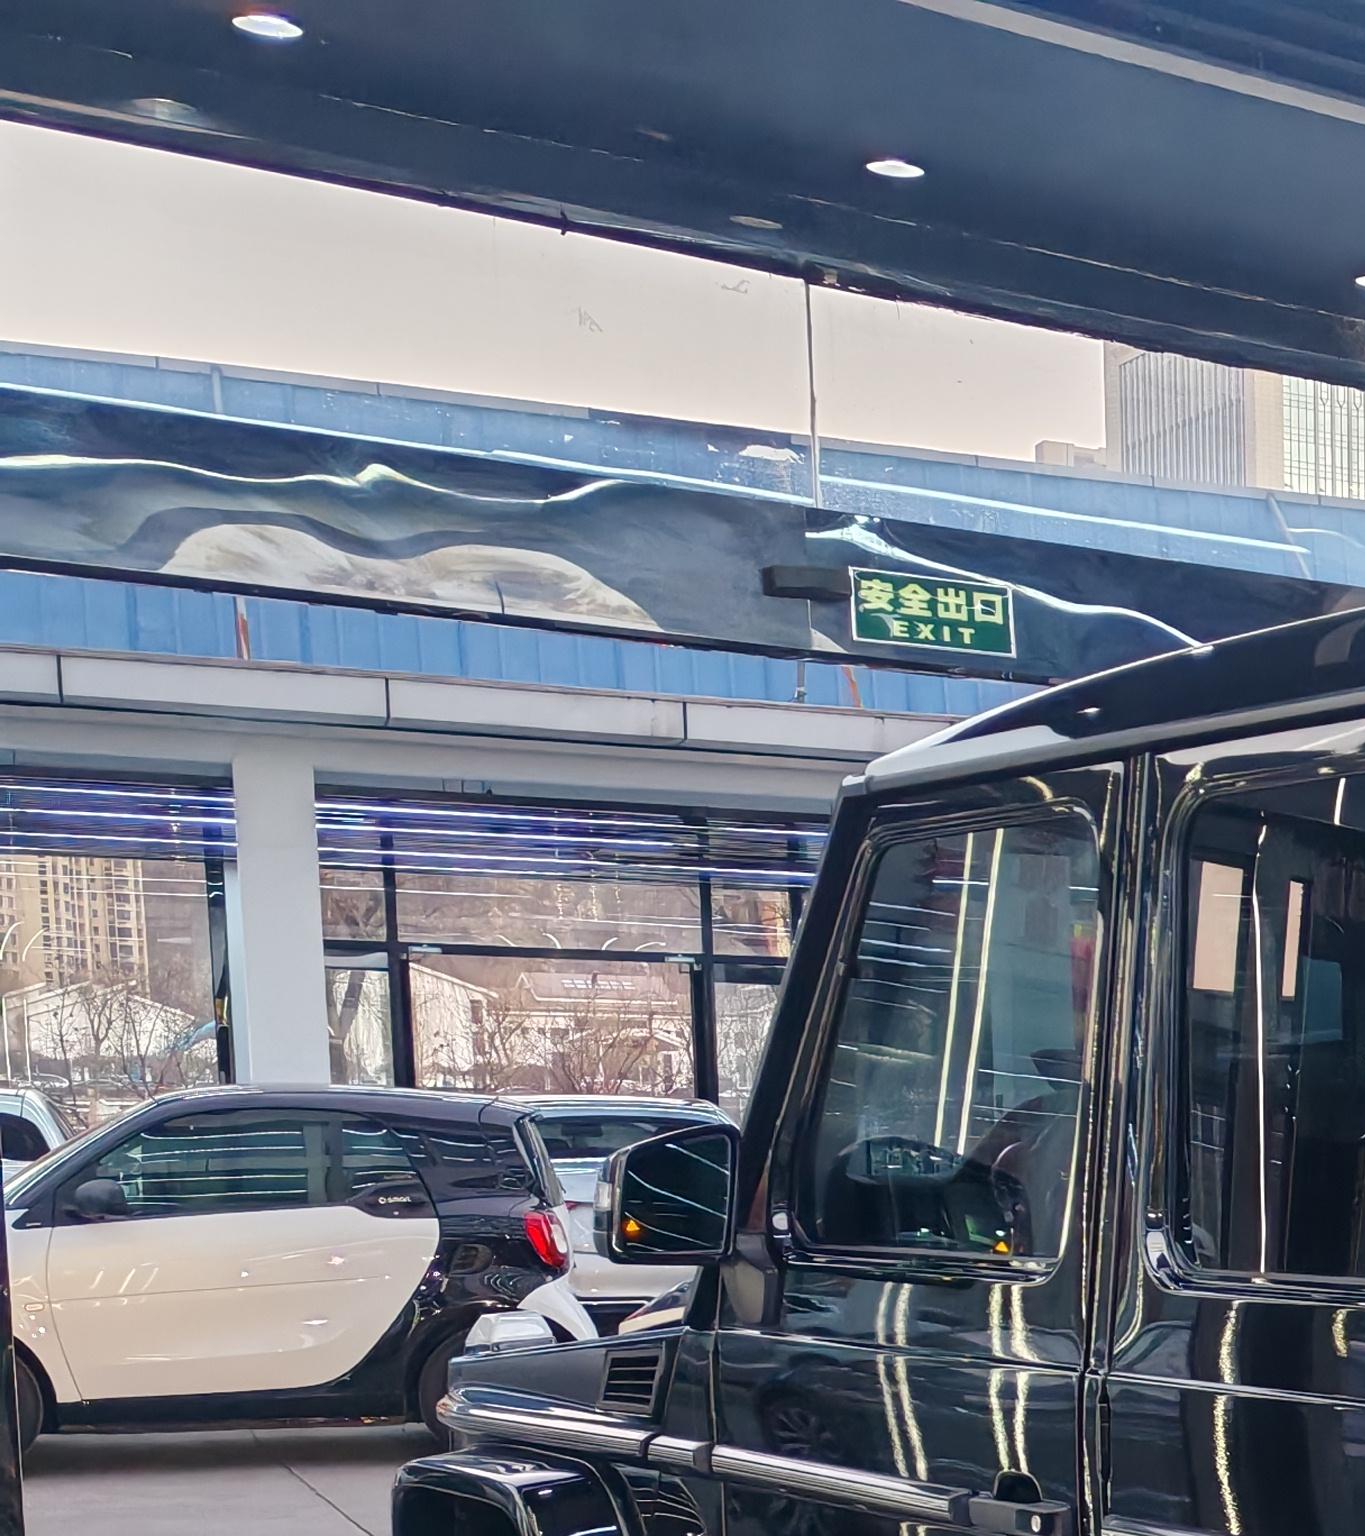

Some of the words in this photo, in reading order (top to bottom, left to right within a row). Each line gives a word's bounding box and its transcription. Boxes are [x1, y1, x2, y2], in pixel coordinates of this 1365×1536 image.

[858, 578, 1004, 625] 安全出口
[893, 620, 976, 645] EXIT
